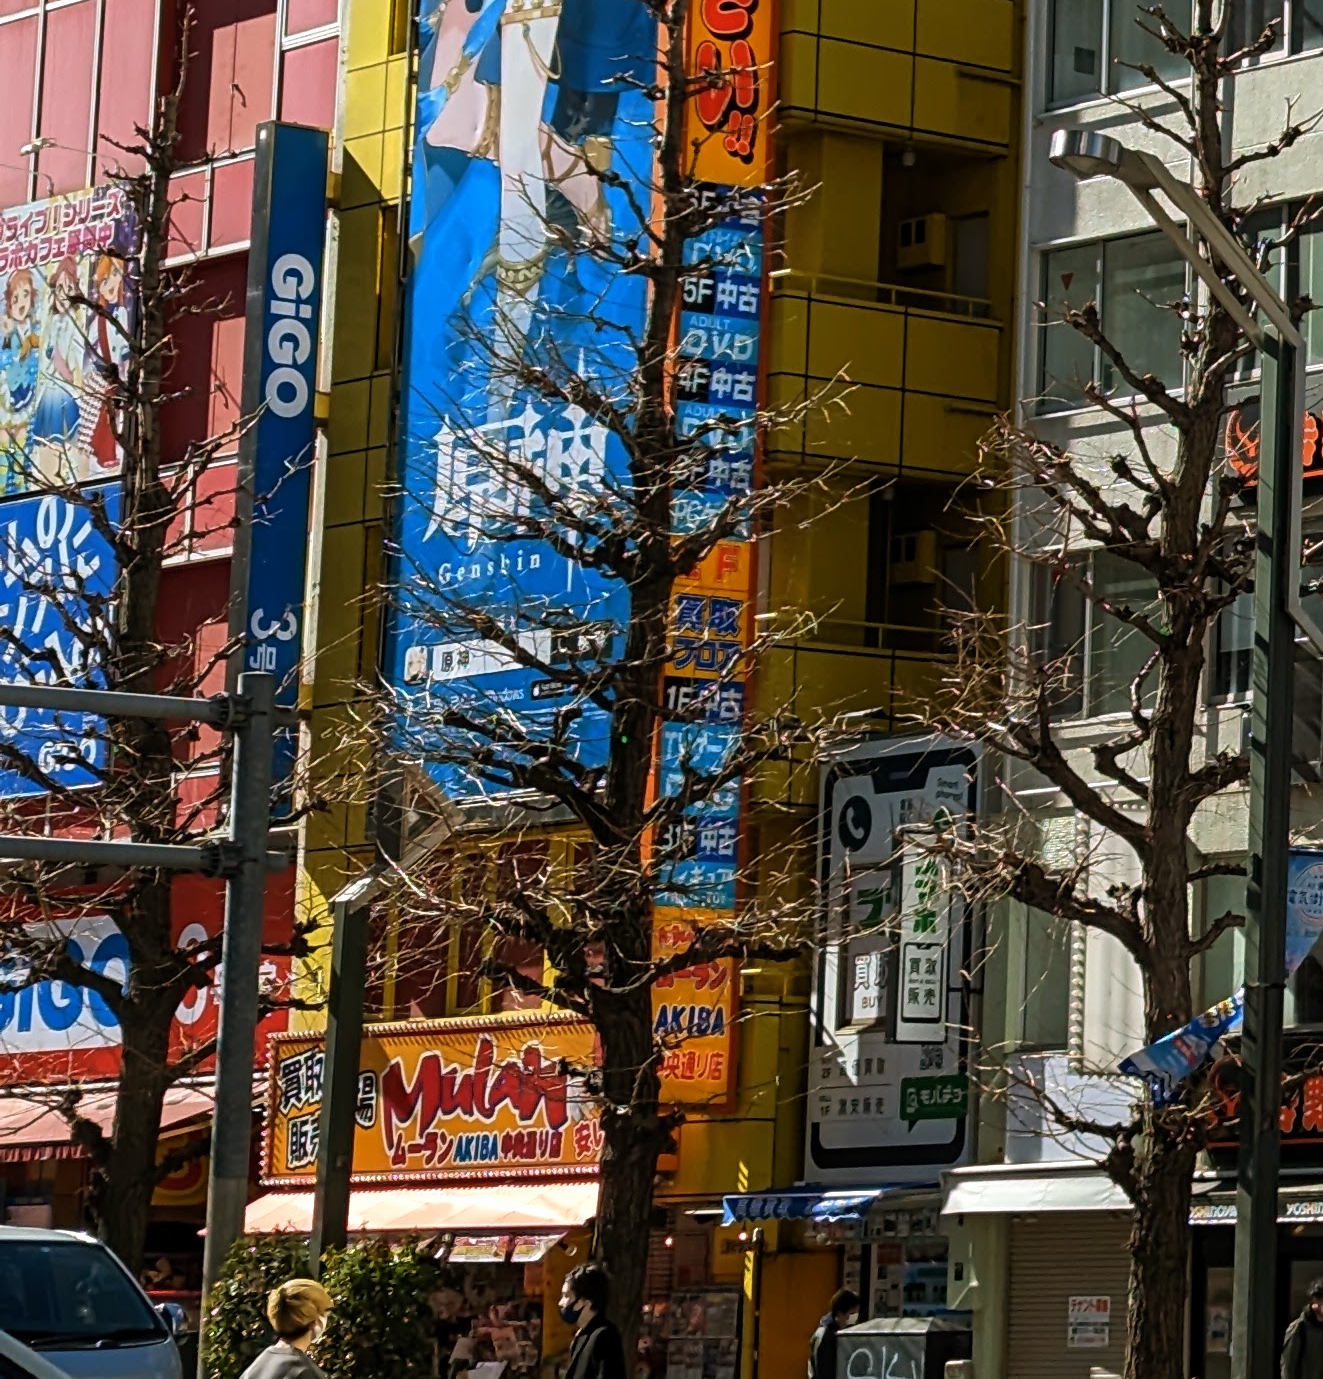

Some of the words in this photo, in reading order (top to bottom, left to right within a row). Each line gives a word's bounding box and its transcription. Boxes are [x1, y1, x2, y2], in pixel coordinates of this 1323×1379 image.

[683, 277, 715, 305] 5F
[716, 279, 760, 315] 中古
[266, 253, 316, 418] GiGO
[688, 315, 732, 331] ADULT
[687, 328, 754, 362] DVD
[711, 366, 757, 403] 中古
[861, 995, 884, 1009] BUY
[654, 1003, 727, 1037] AKIBA
[390, 1128, 453, 1168] ムーラン
[452, 1129, 499, 1164] AKIBA
